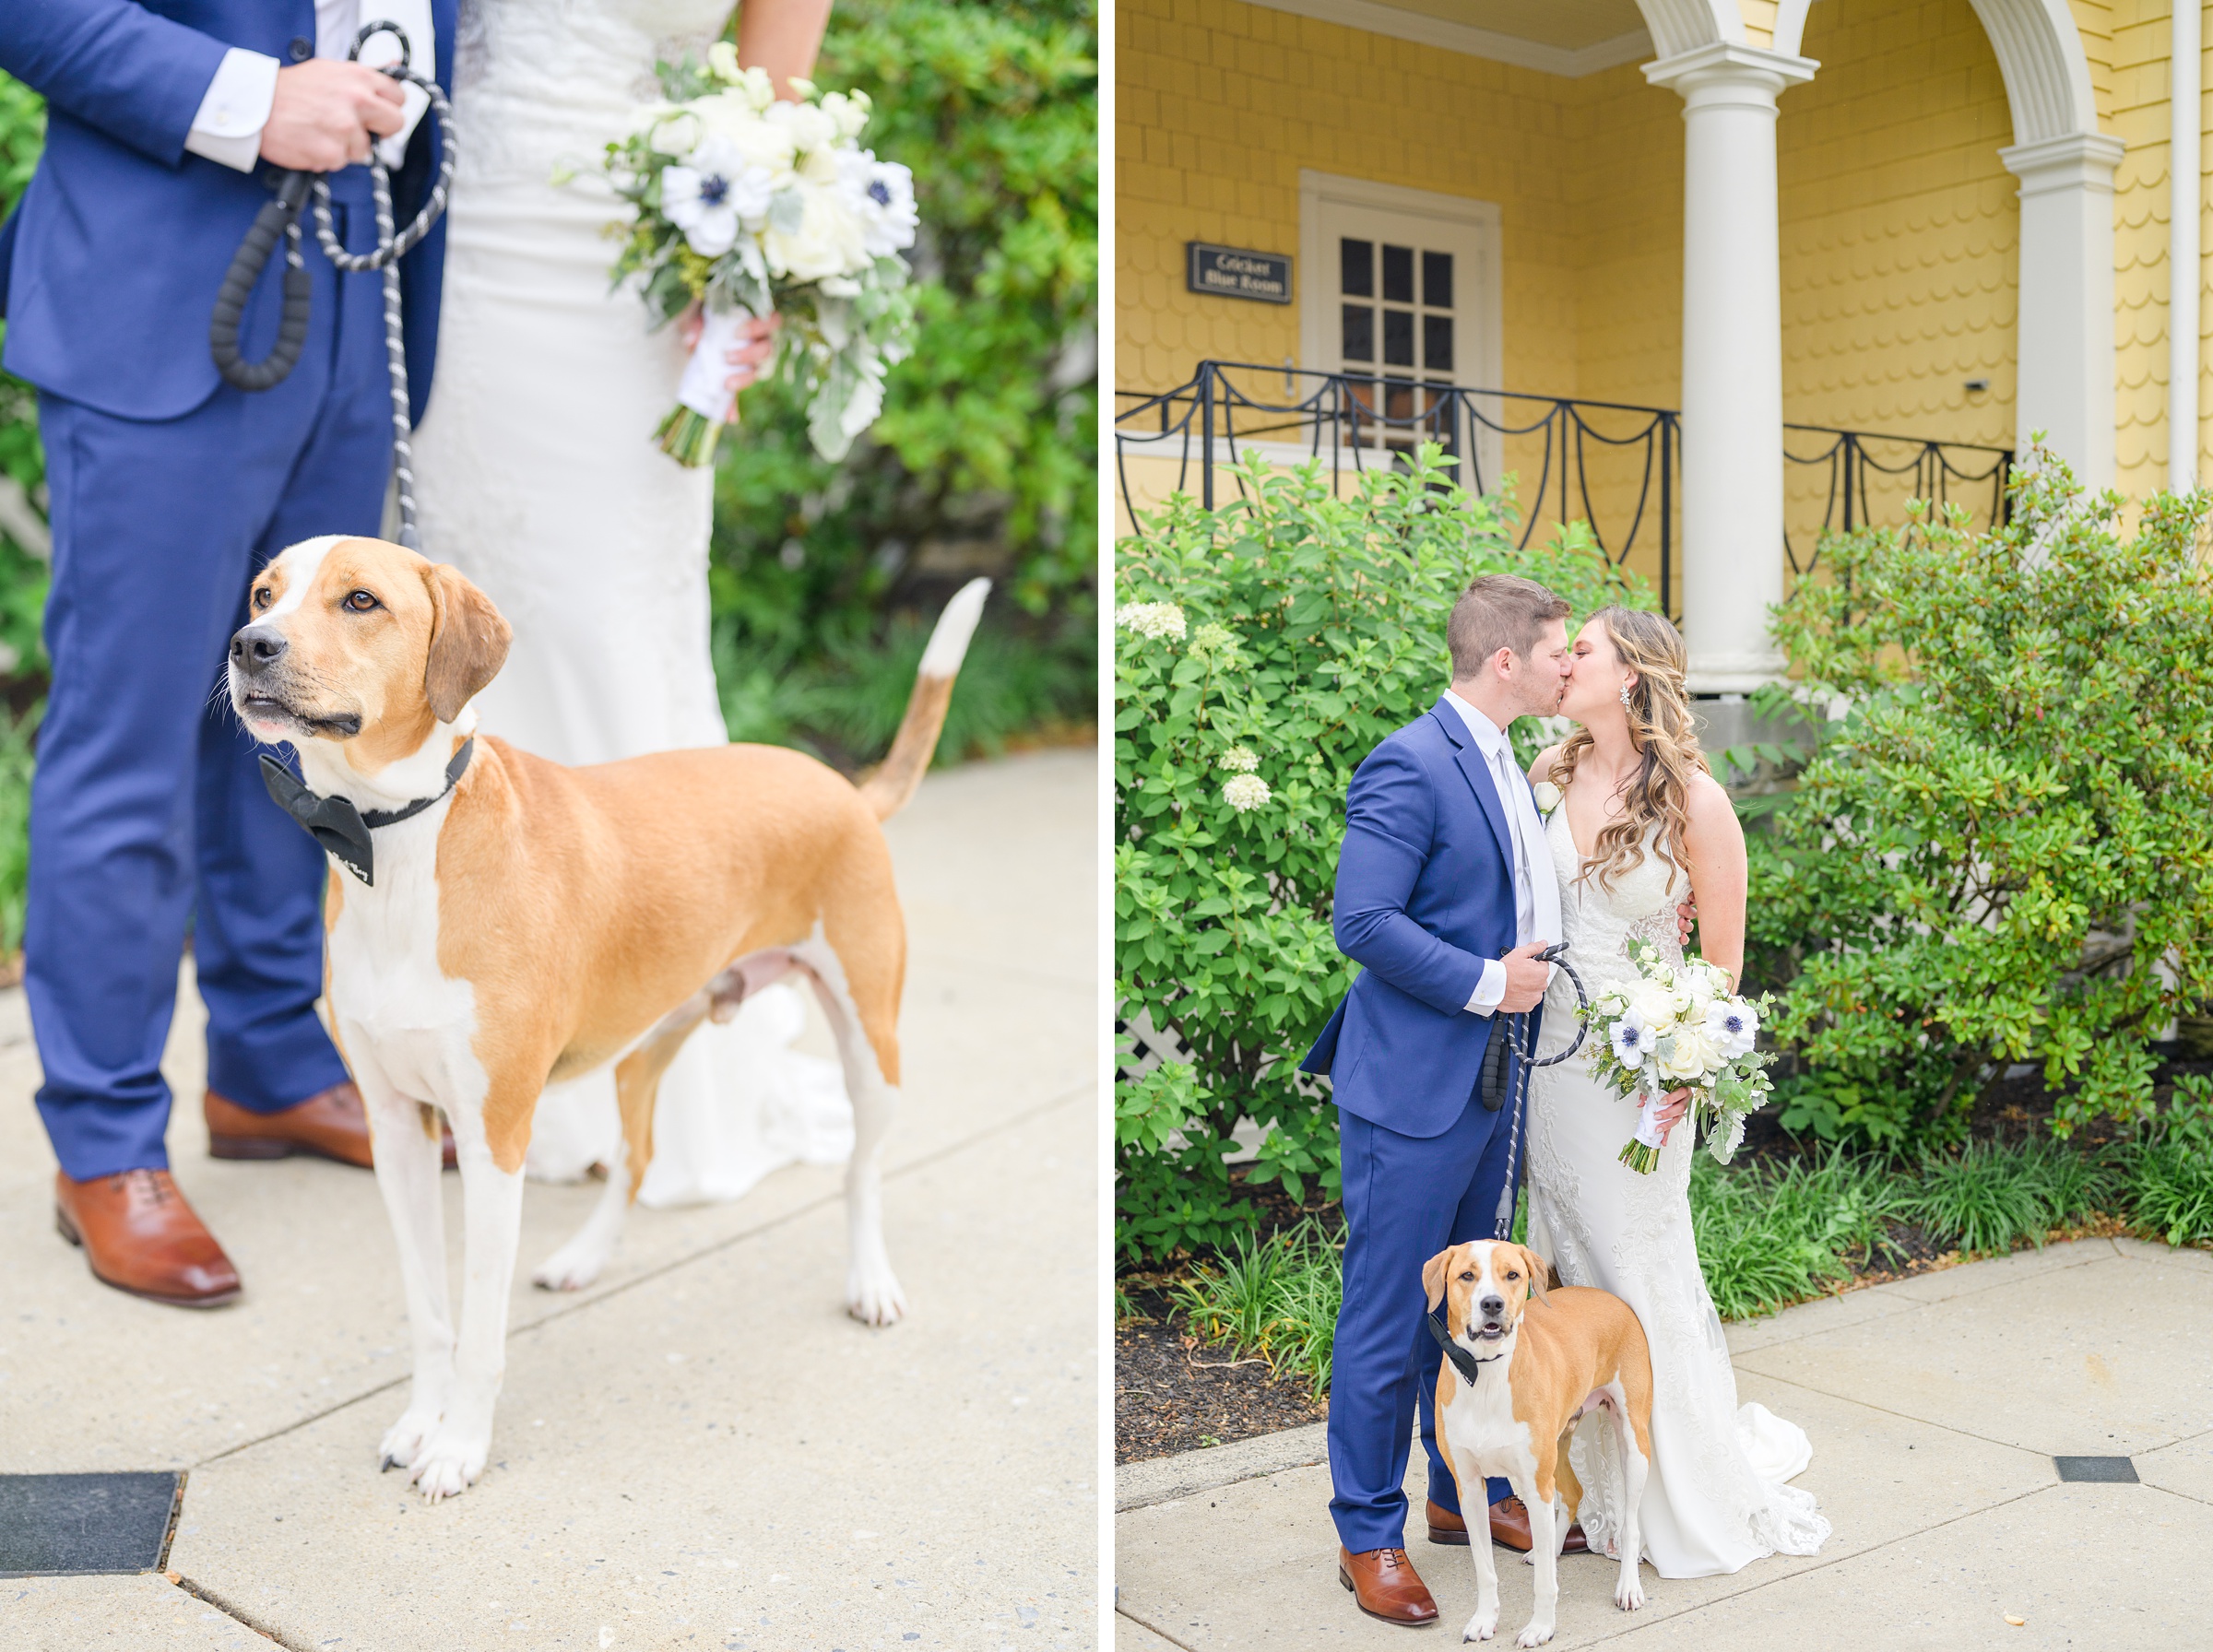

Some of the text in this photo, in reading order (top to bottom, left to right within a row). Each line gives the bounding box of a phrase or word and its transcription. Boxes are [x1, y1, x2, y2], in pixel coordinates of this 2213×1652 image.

[1216, 254, 1271, 277] Cricket
[1205, 268, 1283, 294] Blue Room
